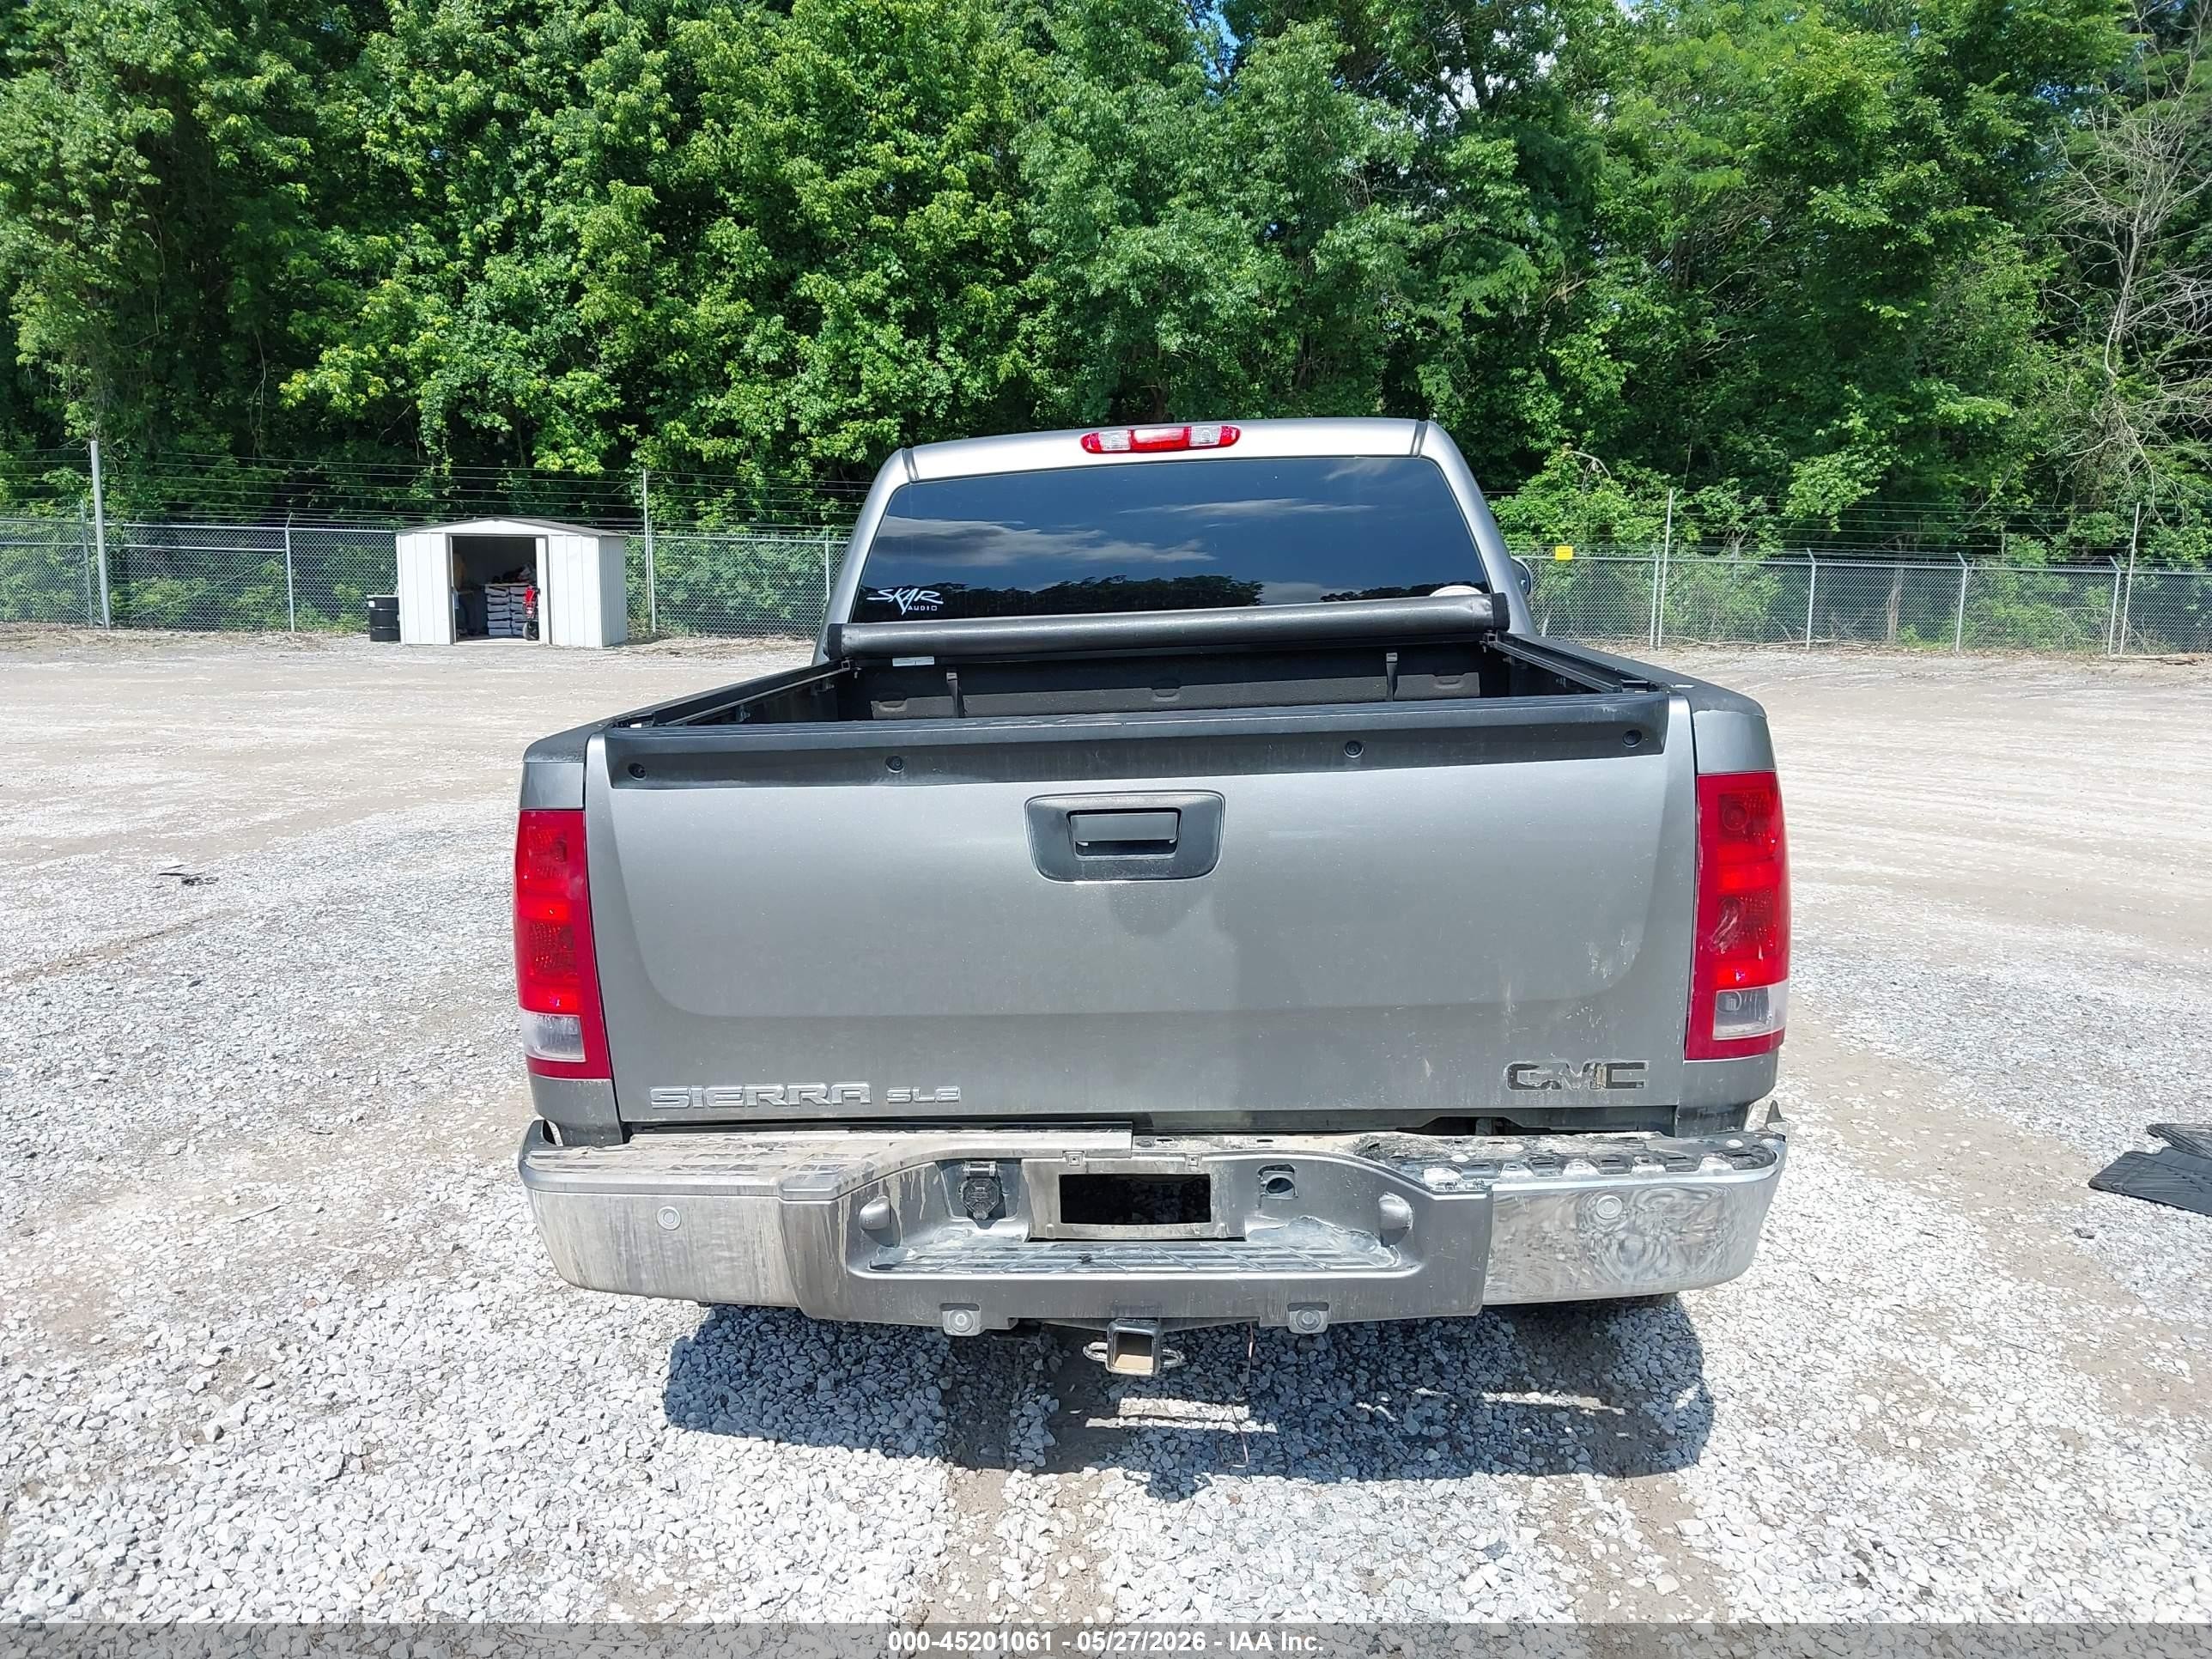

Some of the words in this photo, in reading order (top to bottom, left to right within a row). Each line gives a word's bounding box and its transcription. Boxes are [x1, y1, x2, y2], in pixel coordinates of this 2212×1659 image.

[866, 587, 944, 616] SKAR
[1504, 1059, 1649, 1091] GMC
[650, 1082, 872, 1109] SIERRA
[886, 1085, 961, 1103] SLE
